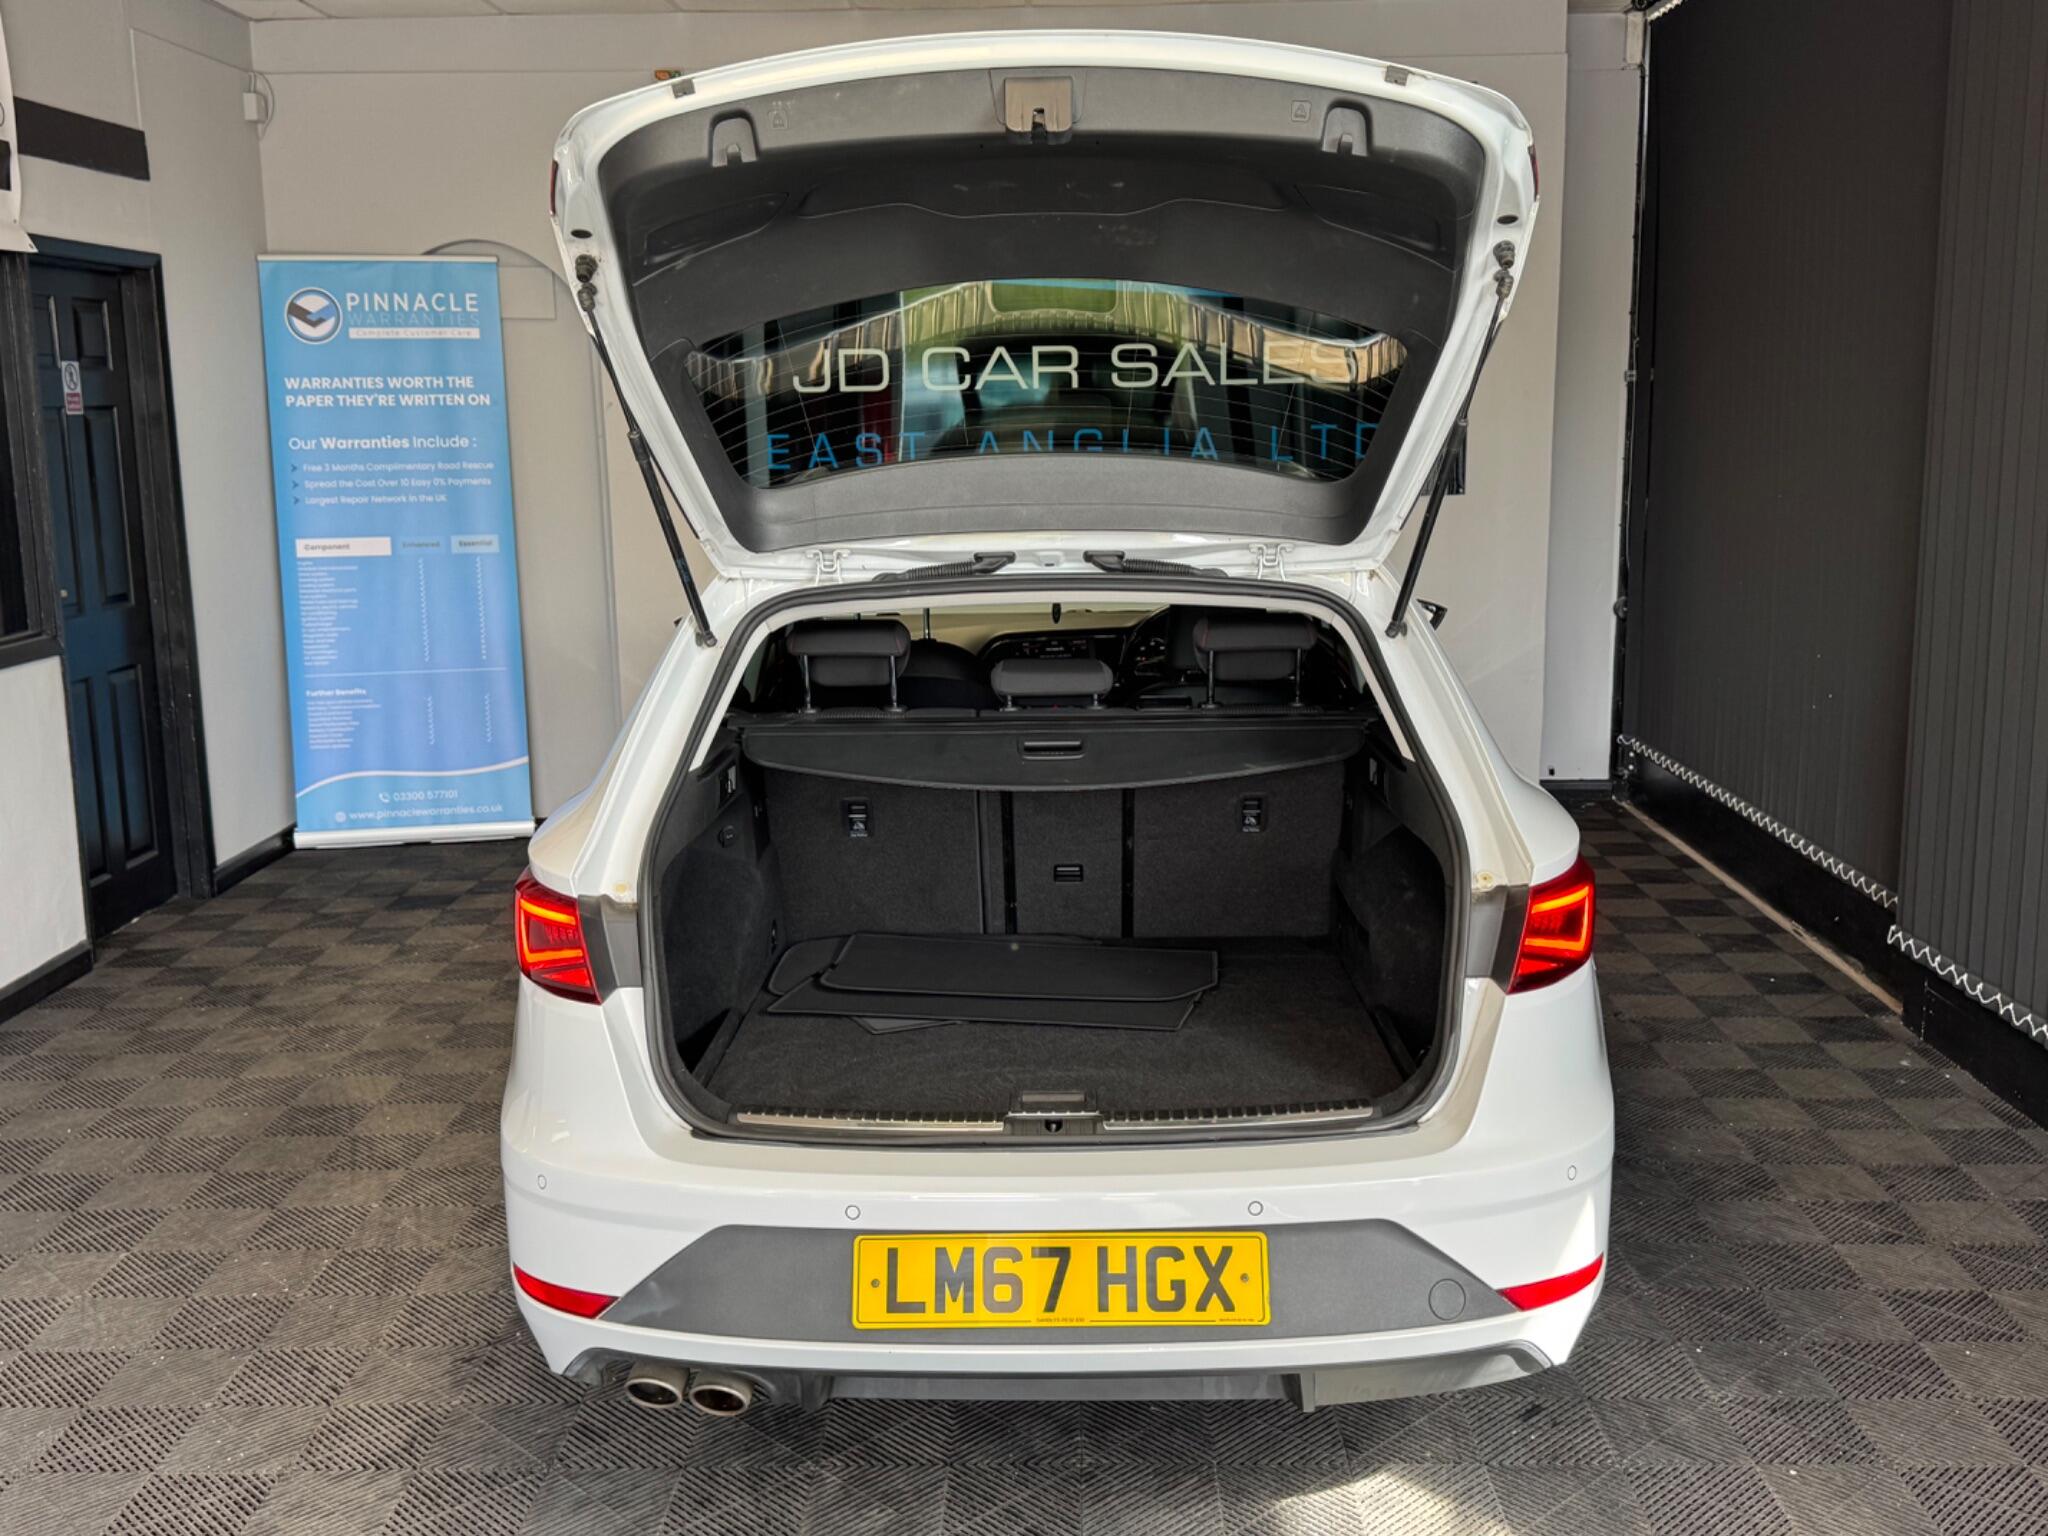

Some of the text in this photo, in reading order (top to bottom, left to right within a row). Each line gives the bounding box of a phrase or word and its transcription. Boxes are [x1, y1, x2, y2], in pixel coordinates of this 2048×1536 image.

[346, 292, 479, 312] PINNACLE
[348, 312, 480, 326] WARRANTIES
[451, 328, 471, 336] Care
[792, 342, 1351, 393] JD CAR SALES
[284, 376, 474, 389] WARRANTIES WORTH THE
[286, 393, 491, 407] PAPER THEY'RE WRITTEN ON
[288, 437, 317, 449] Our
[320, 435, 410, 449] Warranties
[413, 435, 469, 448] Include
[767, 431, 926, 469] EAST
[979, 427, 1218, 460] ANGLIA
[303, 462, 495, 473] Free 3 Months Complimentary Road Rescue
[304, 477, 492, 489] Spread the Cost Over 10 Easy 0% Payments
[305, 496, 339, 506] Largest
[341, 496, 369, 505] Repair
[371, 495, 407, 504] Network
[418, 494, 433, 502] the
[435, 494, 447, 502] UK
[303, 543, 350, 552] Component
[393, 791, 425, 801] 03300
[349, 803, 503, 820] www.pinnaclewarranties.co.uk
[886, 1245, 1236, 1314] LM67 HGX
